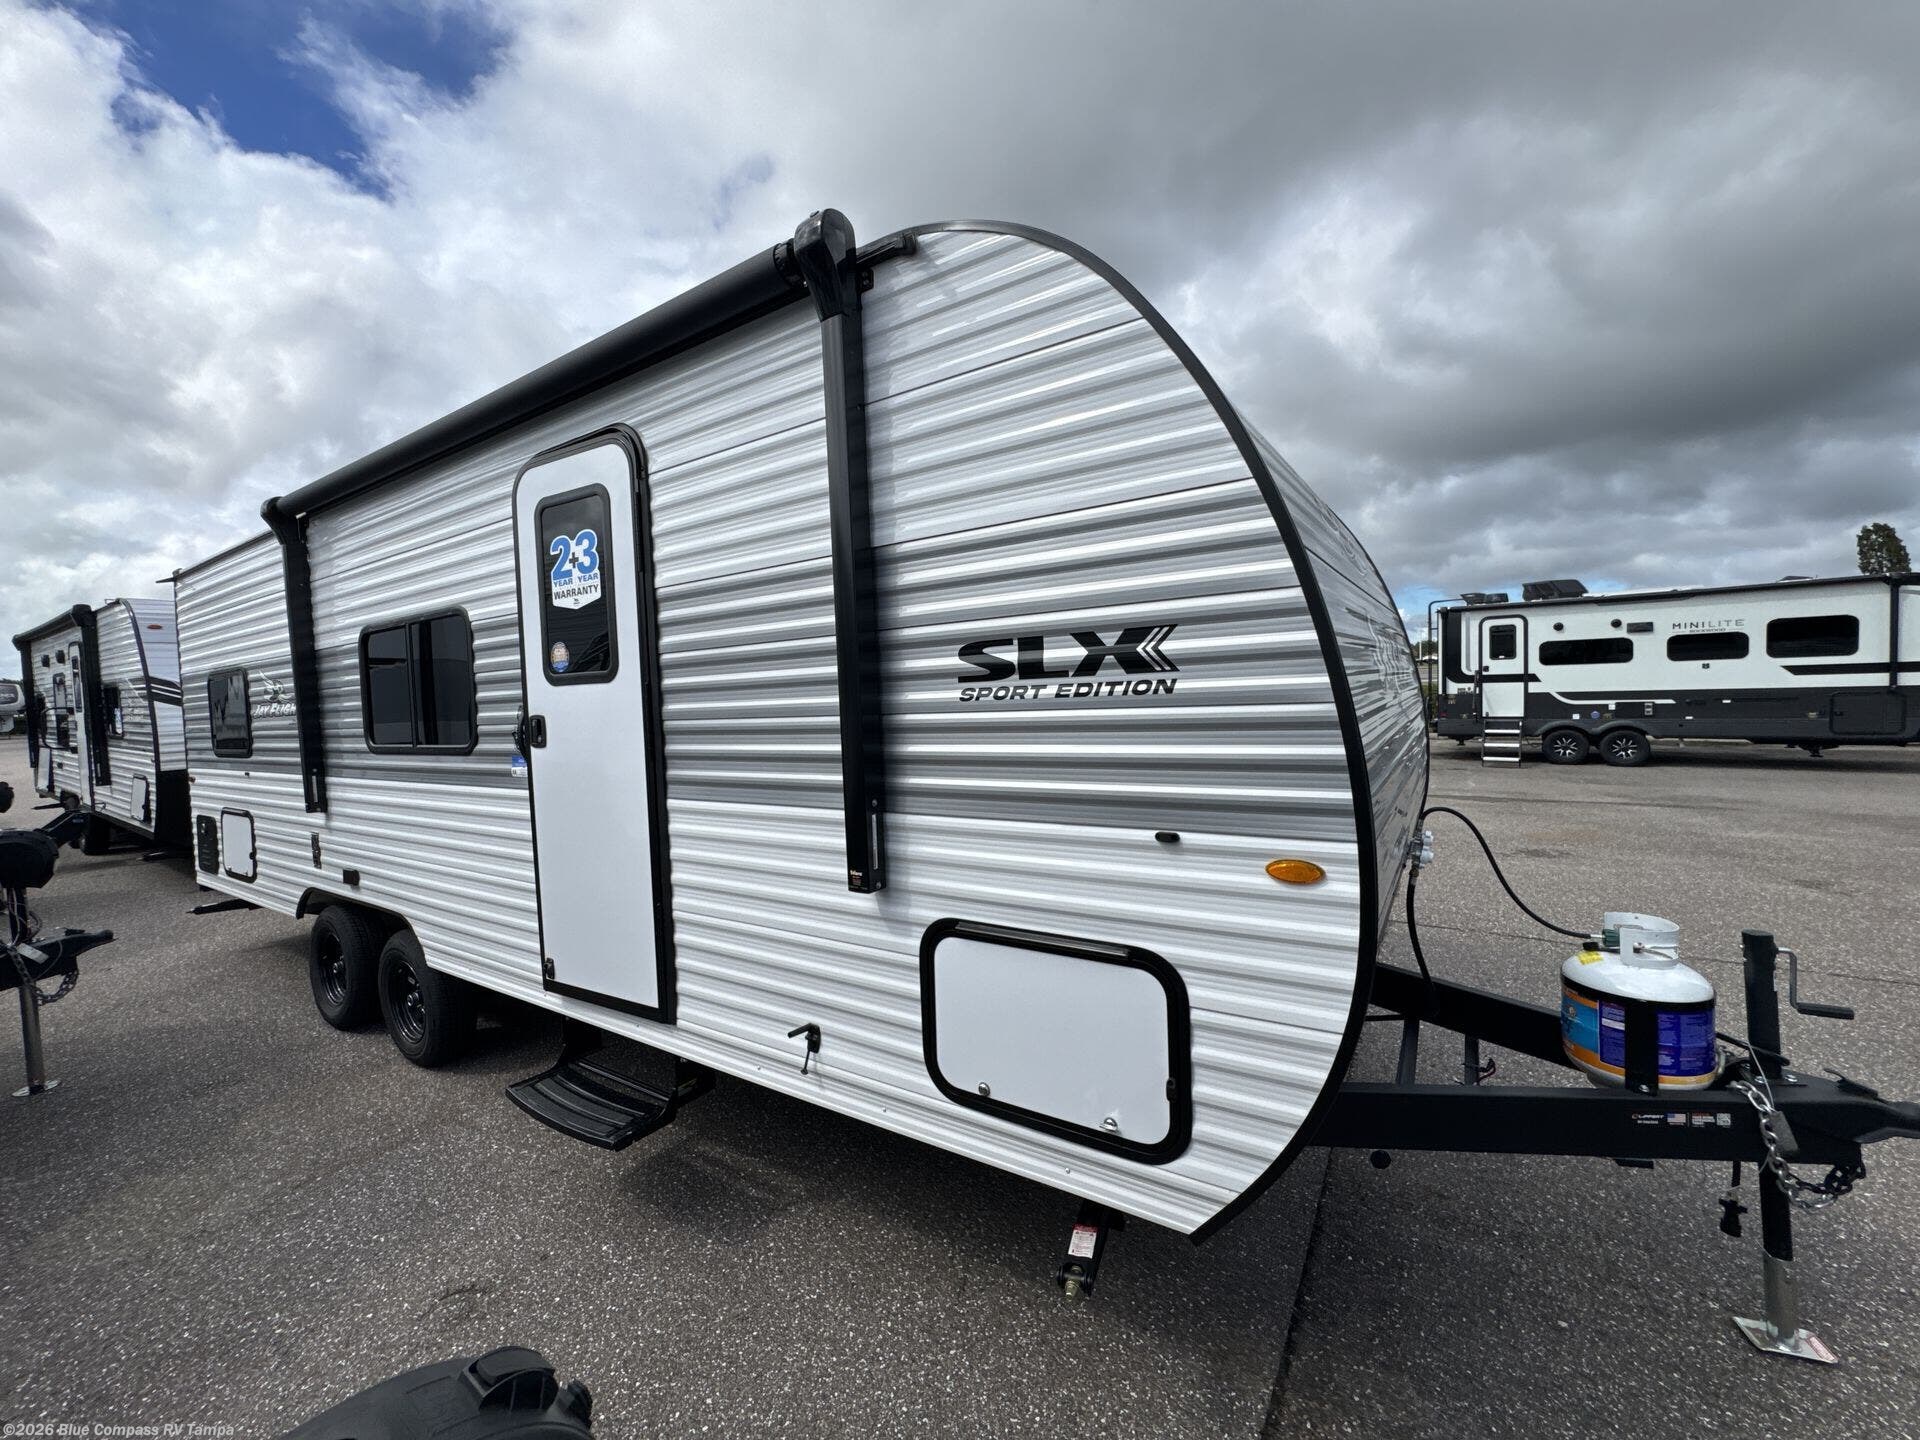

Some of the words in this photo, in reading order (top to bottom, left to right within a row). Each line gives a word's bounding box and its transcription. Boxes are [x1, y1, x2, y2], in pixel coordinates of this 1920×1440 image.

[553, 577, 574, 588] YEAR
[577, 572, 599, 584] YEAR
[553, 583, 600, 600] WARRANTY
[1672, 618, 1745, 630] MINILITE
[957, 623, 1181, 683] SLX
[958, 684, 1048, 702] SPORT
[1054, 678, 1178, 699] EDITION
[270, 702, 297, 717] FLIGH
